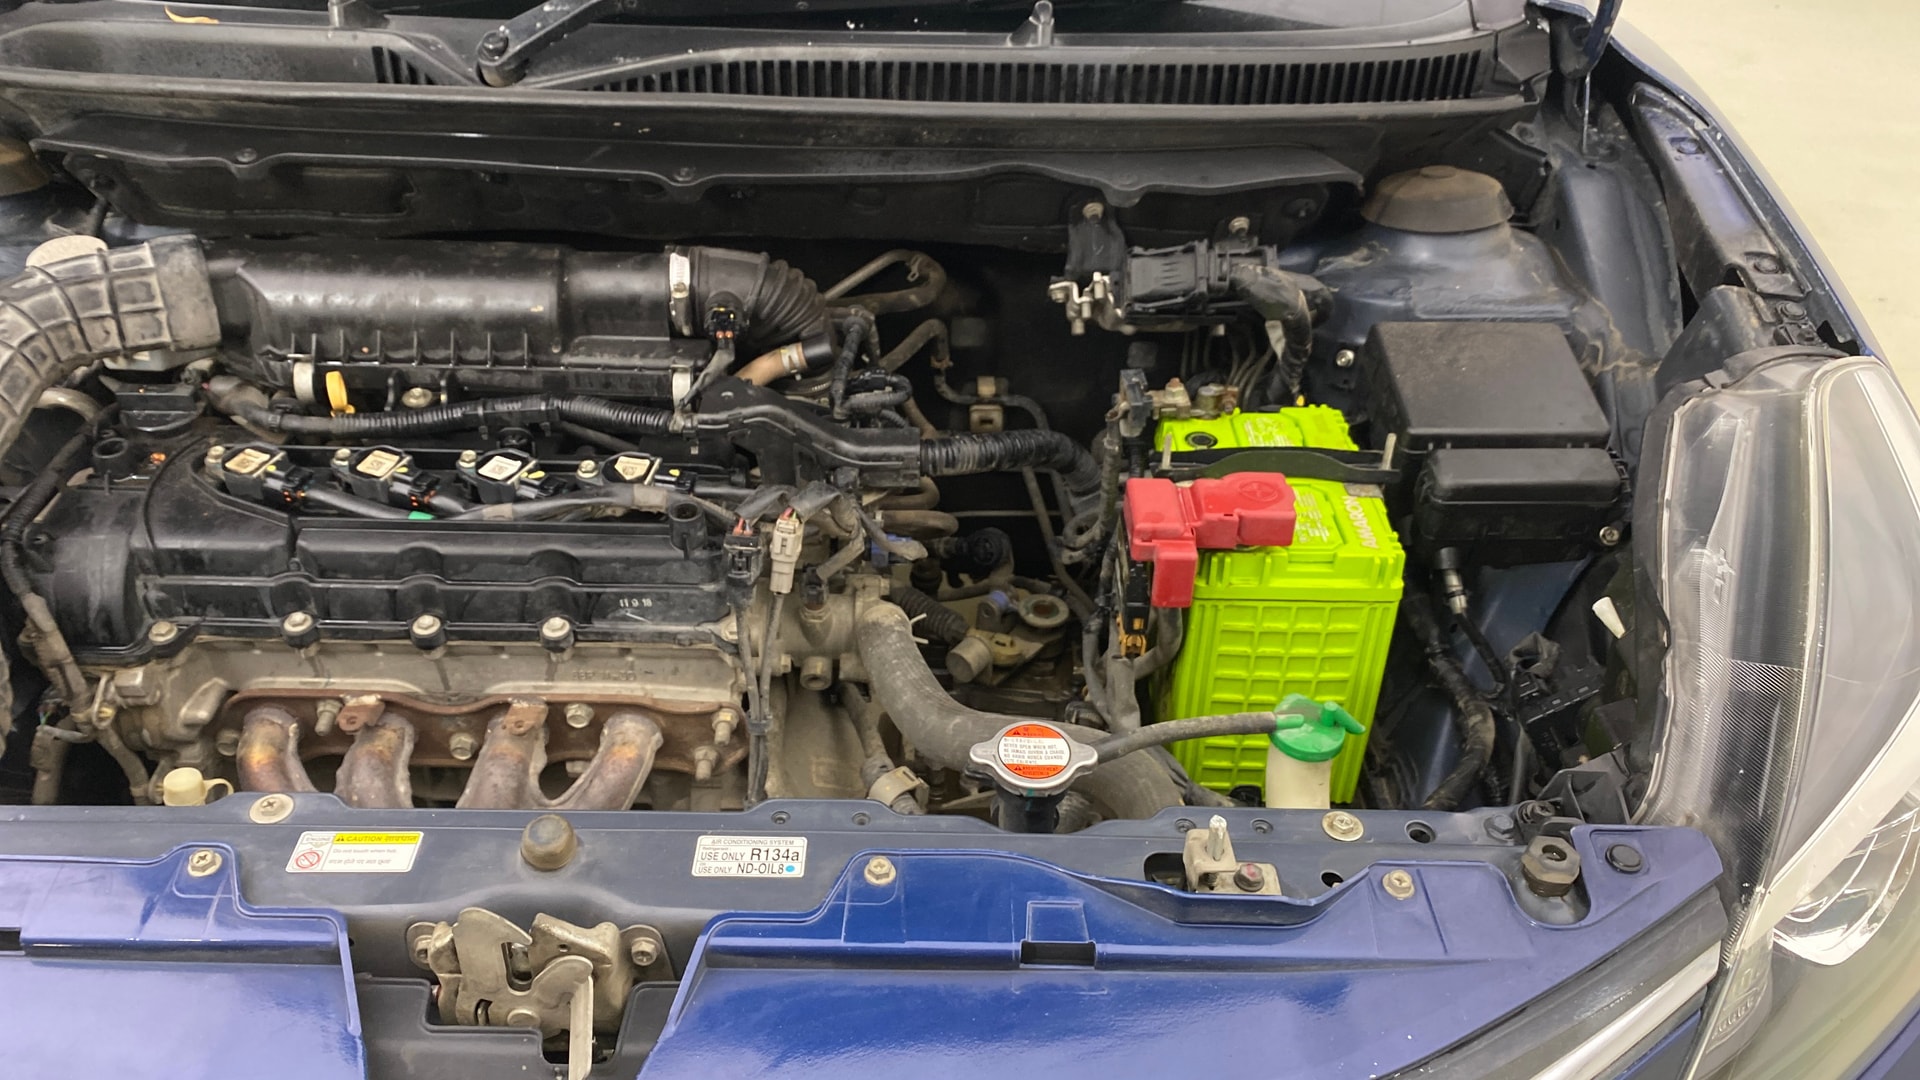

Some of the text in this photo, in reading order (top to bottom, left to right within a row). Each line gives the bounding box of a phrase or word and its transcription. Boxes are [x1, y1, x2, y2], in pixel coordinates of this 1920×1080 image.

[1343, 495, 1379, 549] AMARON
[701, 847, 800, 861] USE ONLY R134a
[698, 863, 784, 874] USE ONLY ND-OIL8
